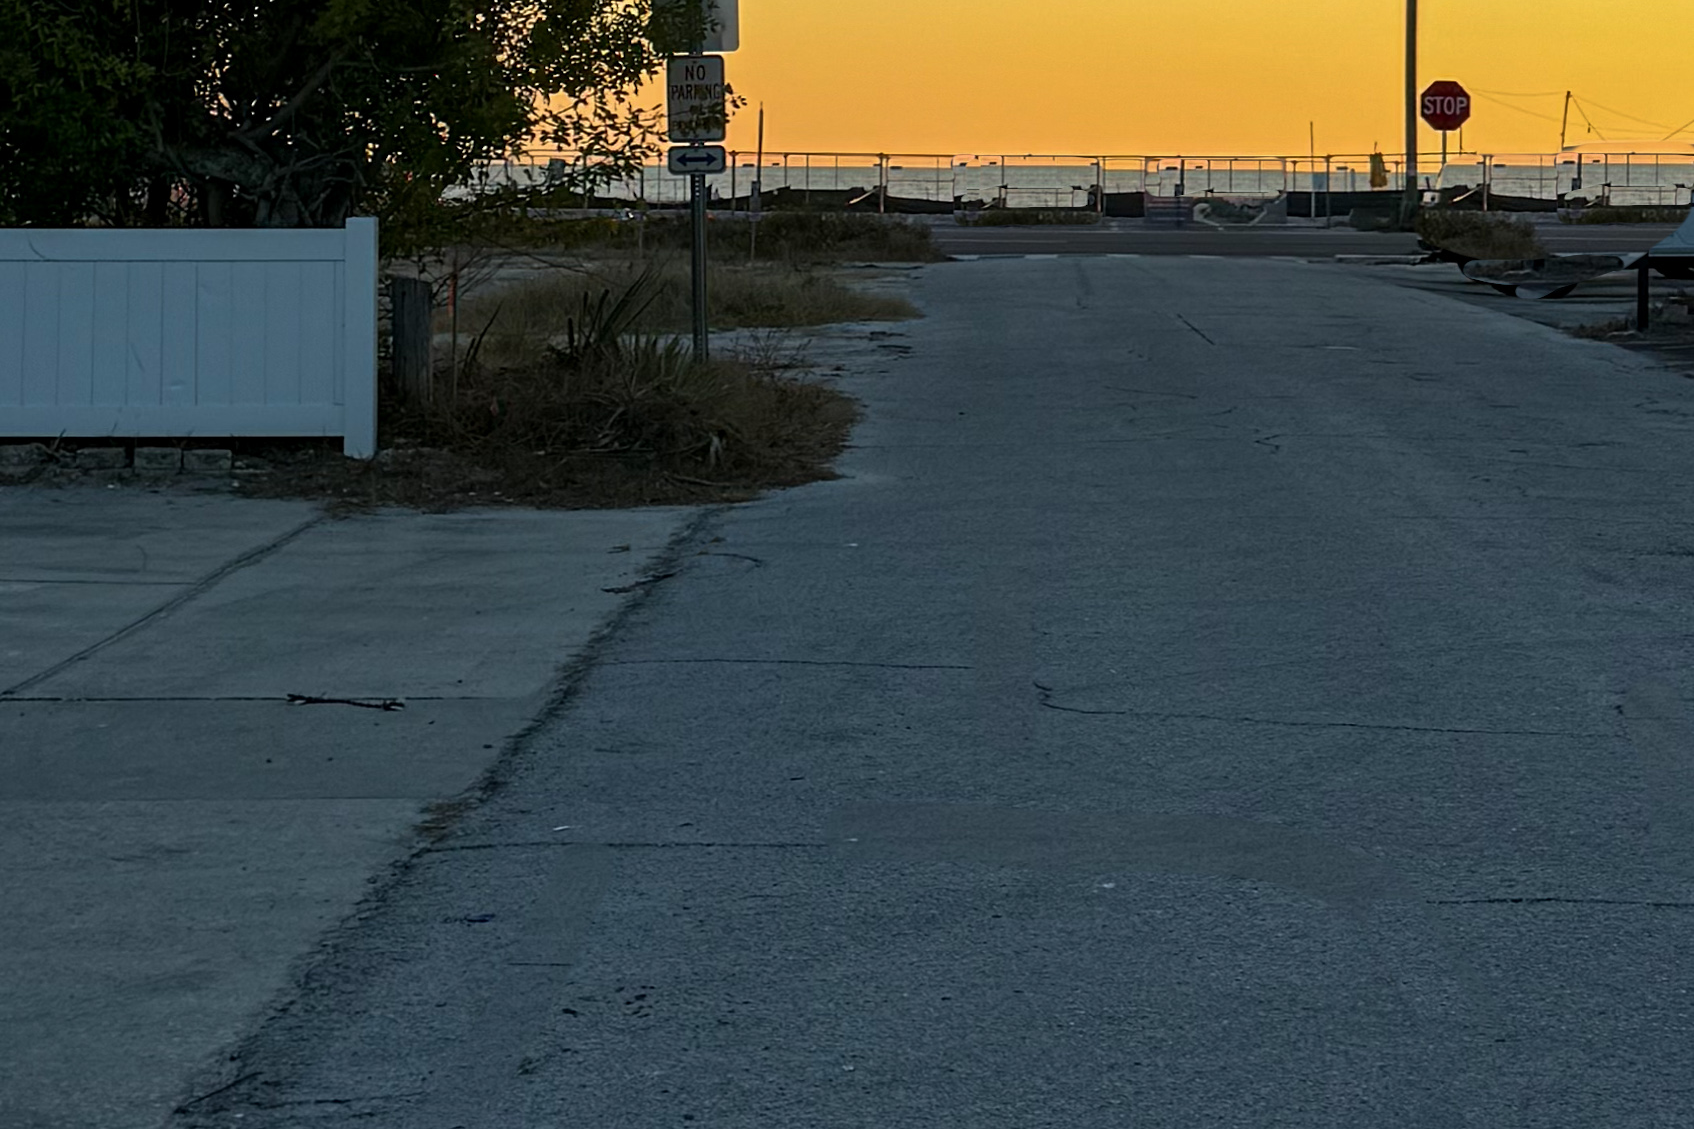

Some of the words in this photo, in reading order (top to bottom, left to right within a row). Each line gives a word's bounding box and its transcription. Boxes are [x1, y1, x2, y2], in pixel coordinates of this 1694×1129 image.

[685, 65, 706, 81] NO
[671, 83, 721, 100] PARNG
[1423, 96, 1467, 115] STOP
